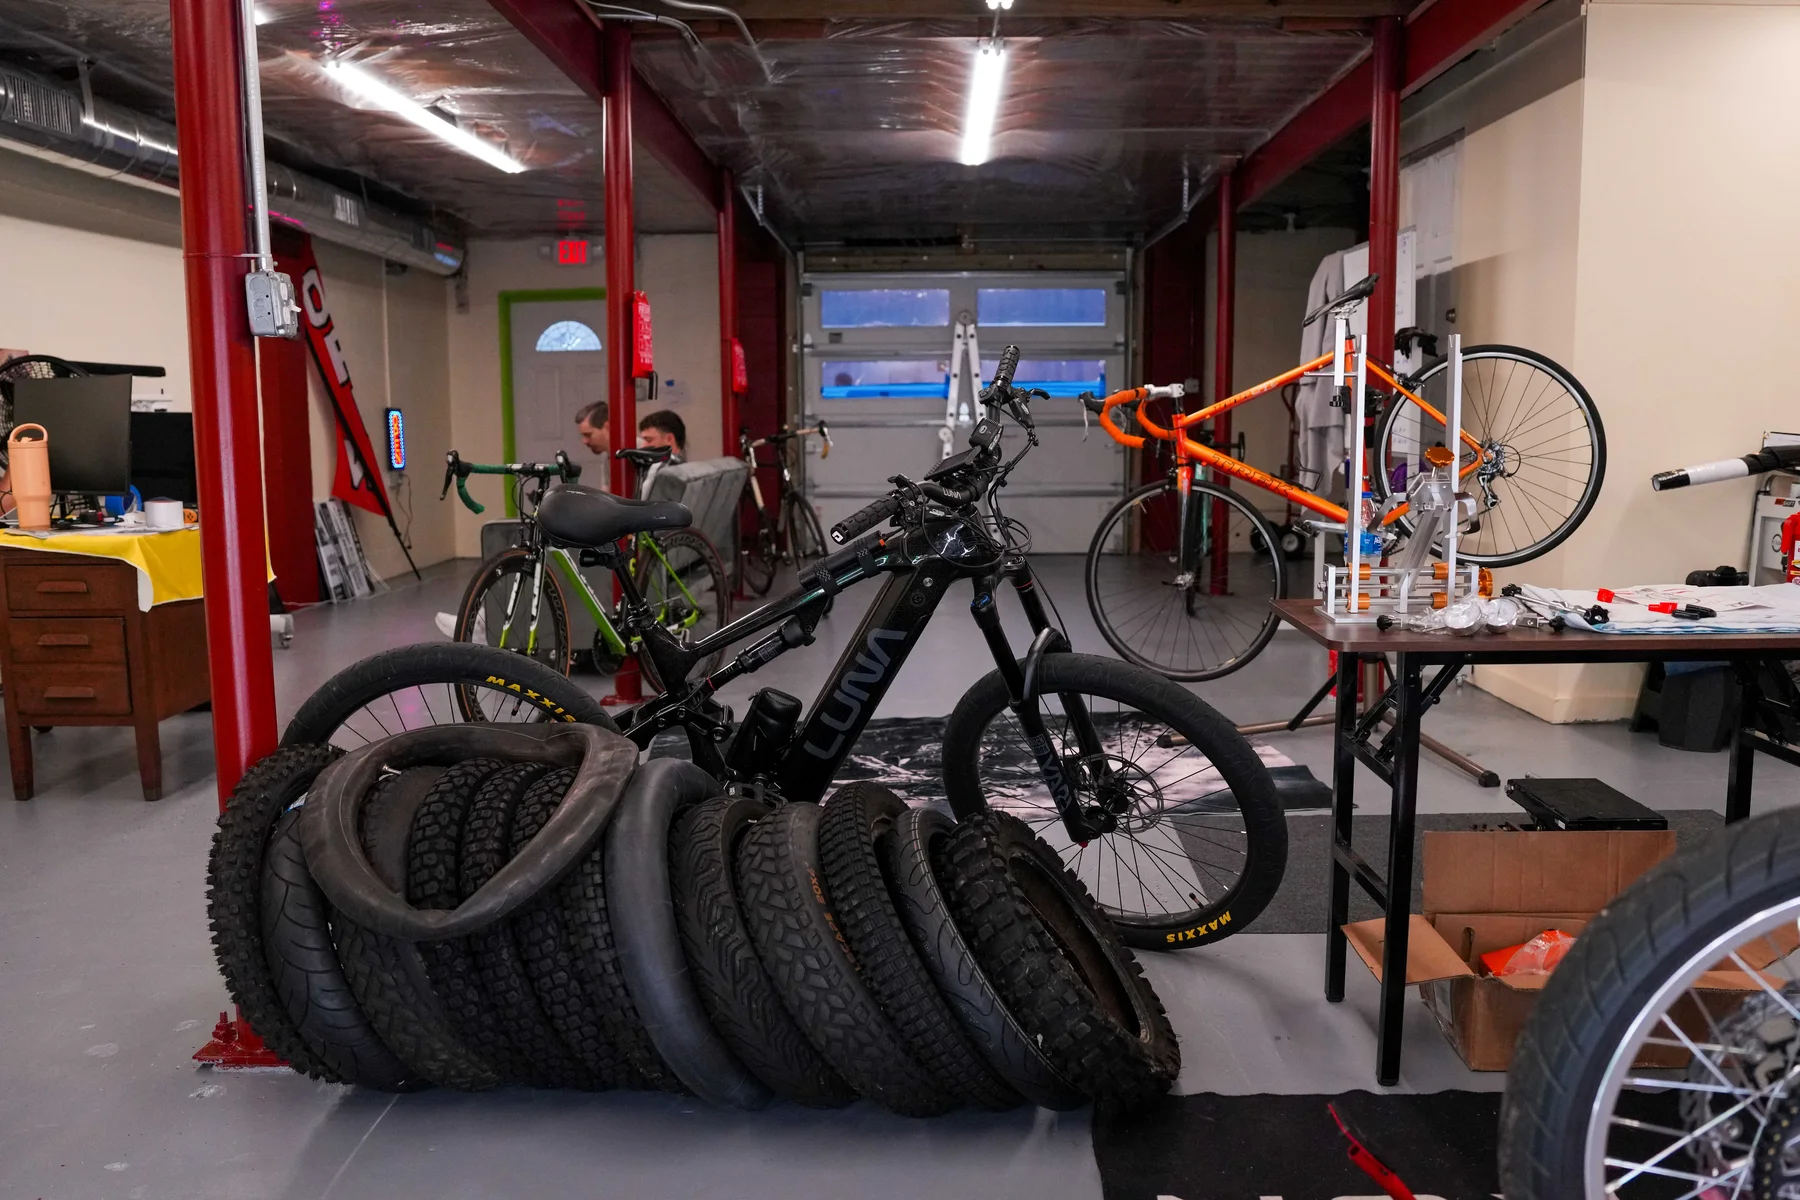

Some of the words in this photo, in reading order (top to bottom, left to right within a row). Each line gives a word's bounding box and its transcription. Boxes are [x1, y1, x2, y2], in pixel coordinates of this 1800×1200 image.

[558, 240, 588, 264] EXIT
[1212, 453, 1294, 498] TREK
[485, 675, 577, 723] MAXXIS
[803, 627, 908, 760] LUNA
[1165, 910, 1232, 943] MAXXIS
